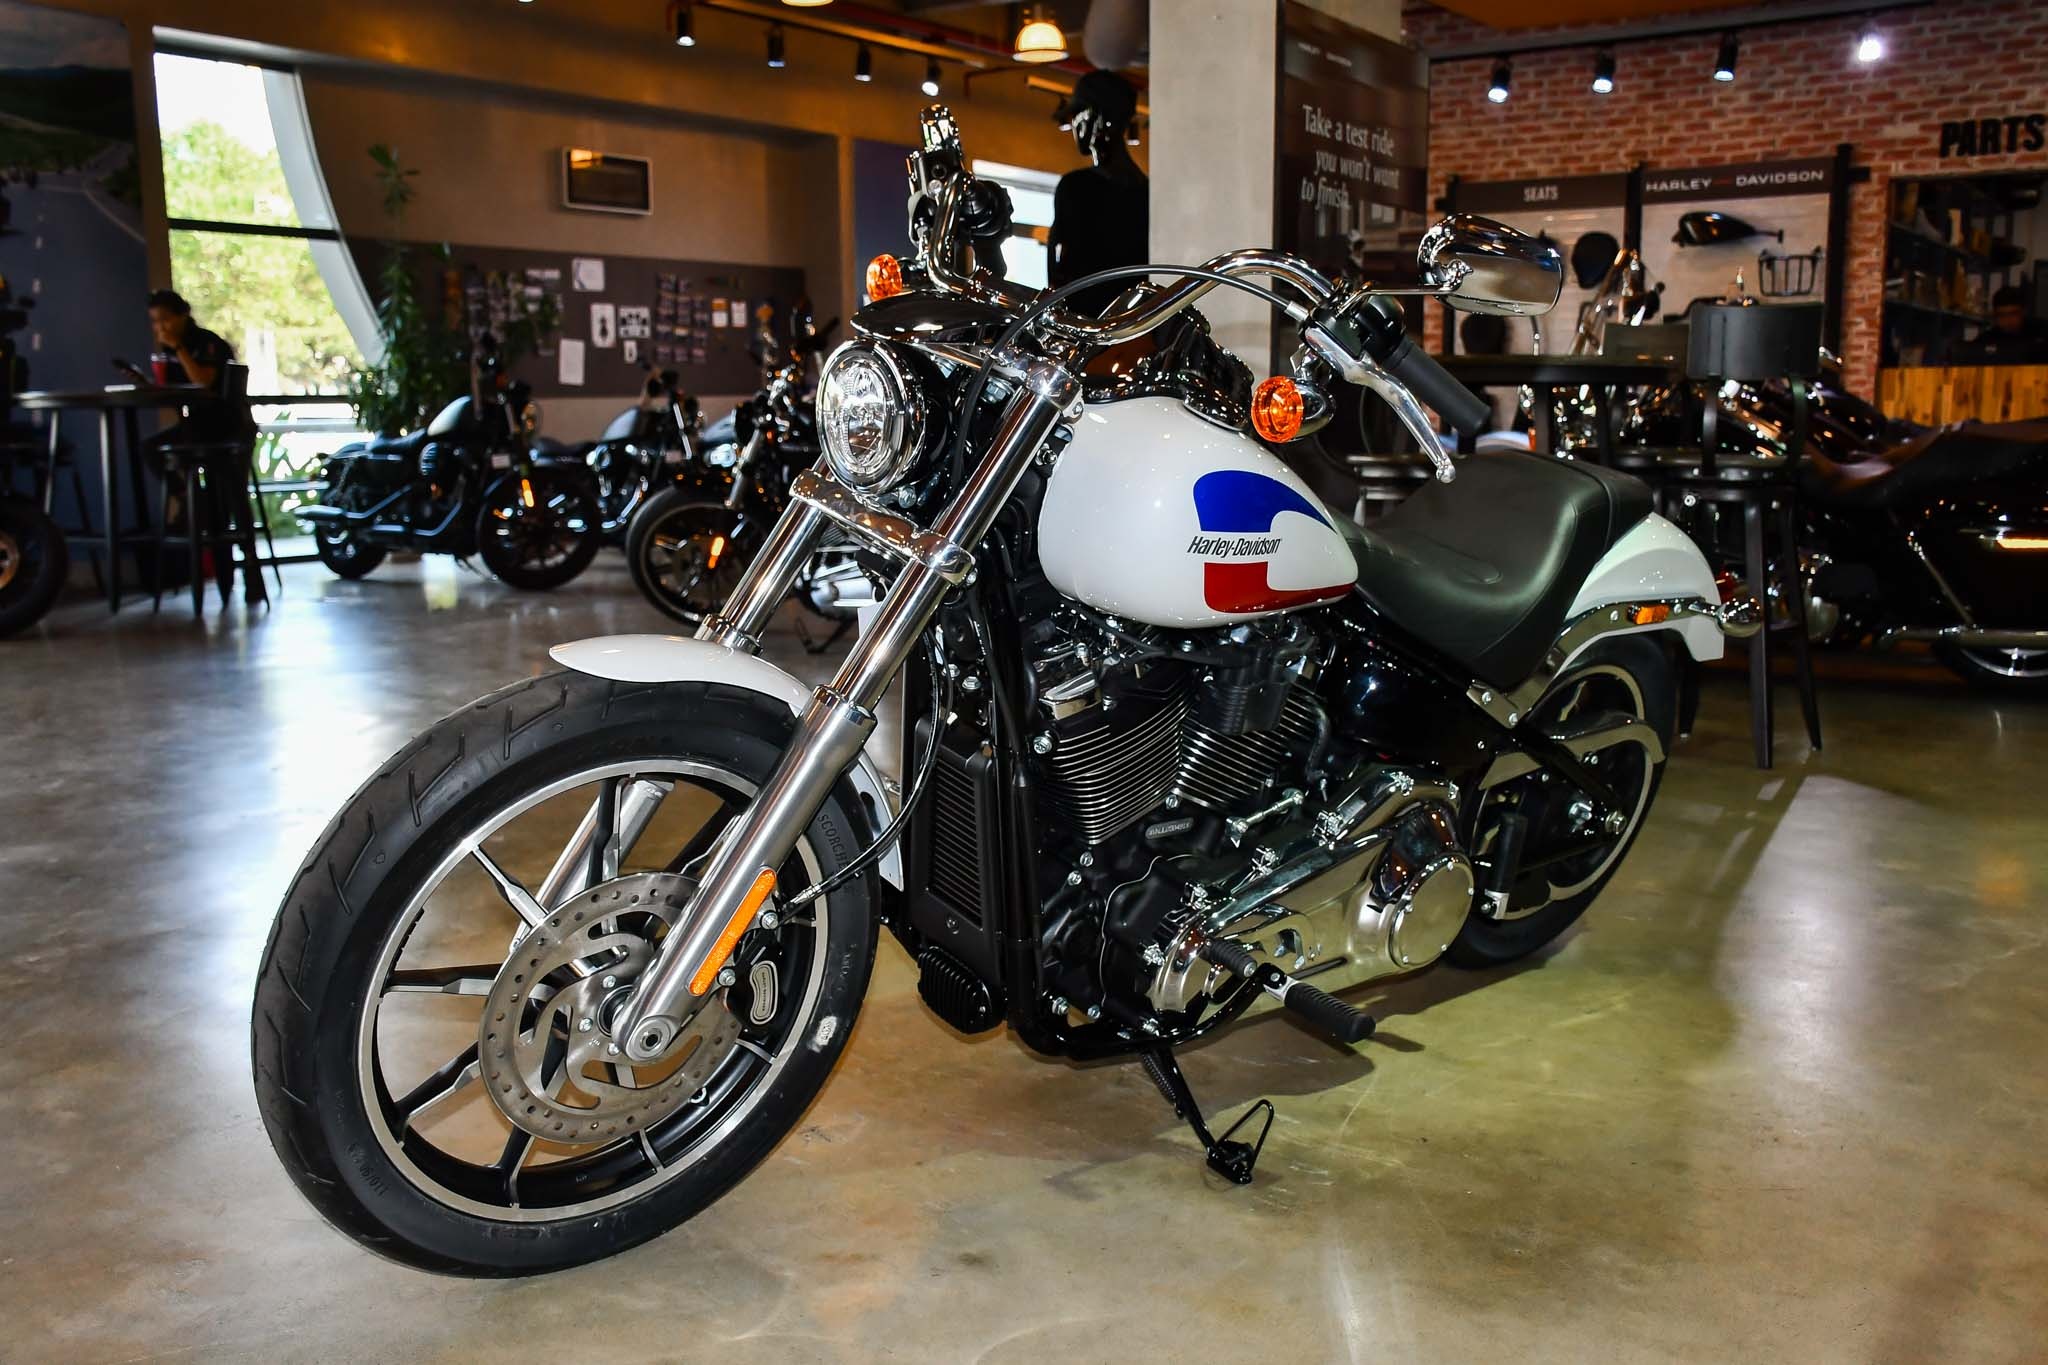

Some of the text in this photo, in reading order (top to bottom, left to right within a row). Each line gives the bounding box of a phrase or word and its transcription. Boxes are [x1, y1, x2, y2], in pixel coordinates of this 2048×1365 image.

[1302, 103, 1395, 157] Take a test ride
[1940, 113, 2046, 158] PARTS
[1313, 150, 1337, 176] you
[1339, 156, 1371, 182] won't
[1645, 169, 1825, 192] HARLEY DAVIDSON
[1301, 177, 1314, 202] to
[1186, 535, 1282, 559] Harley-Davidson
[816, 814, 850, 871] SCORCHE
